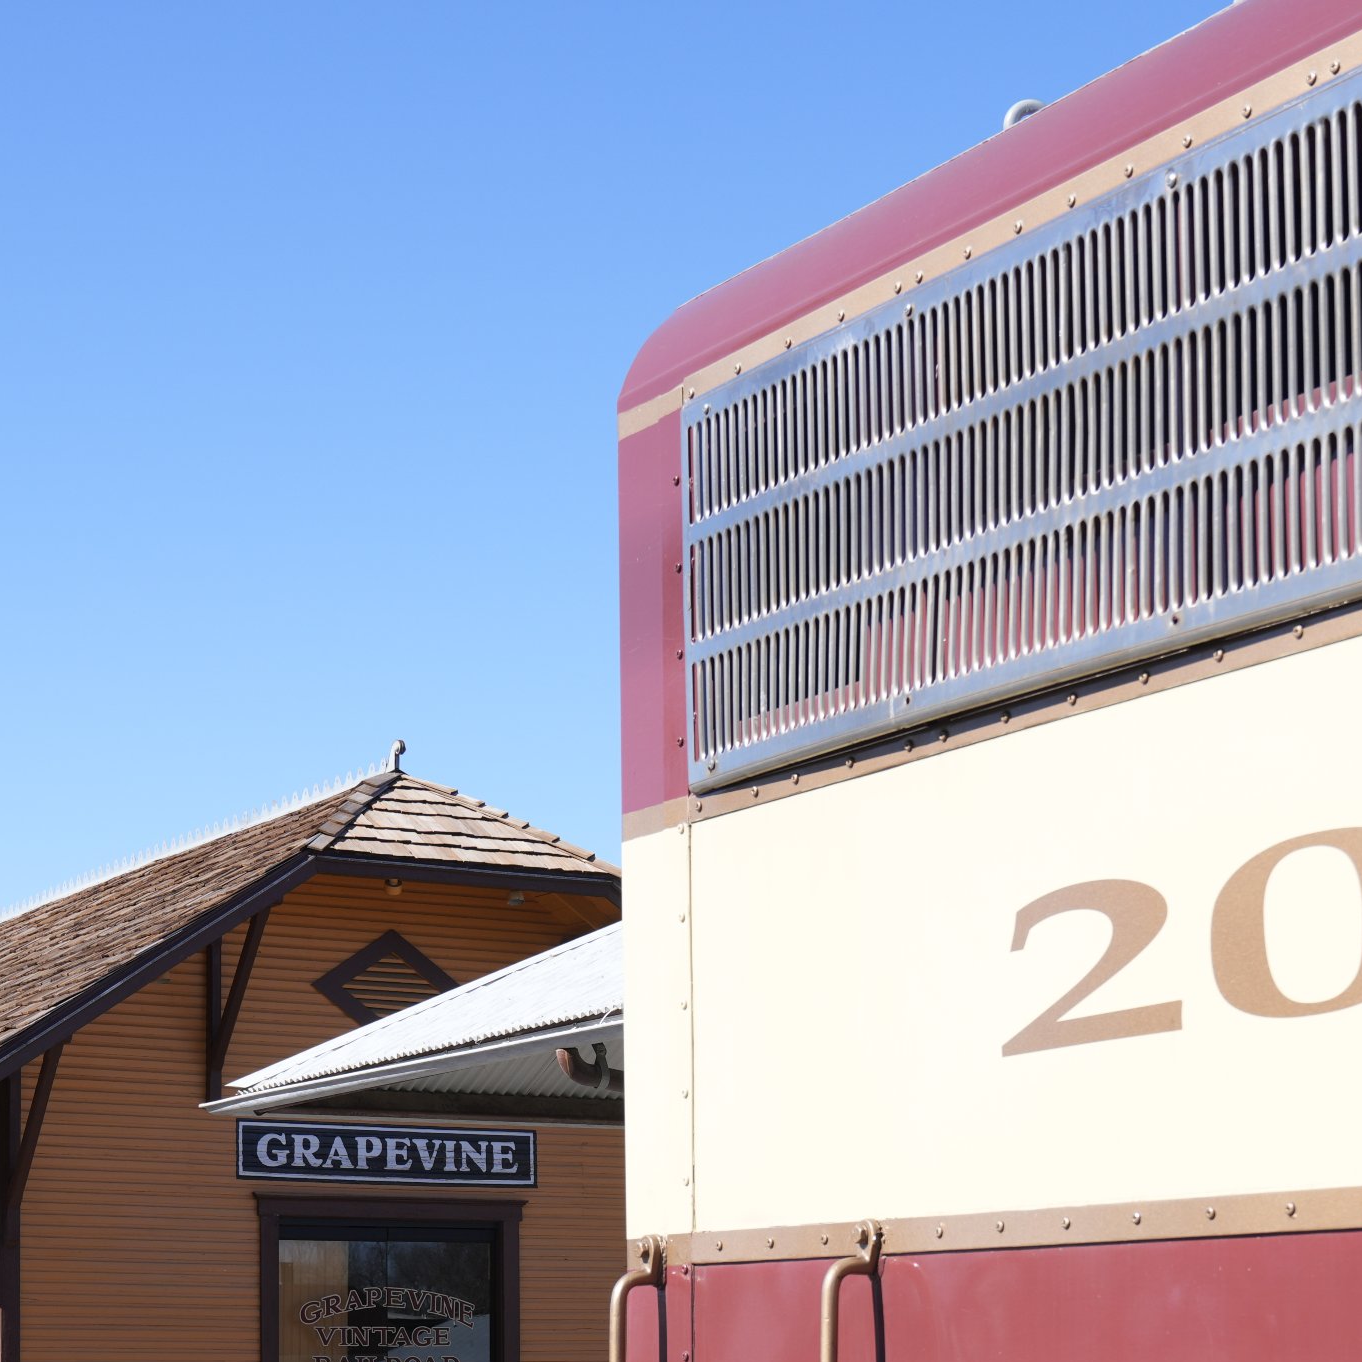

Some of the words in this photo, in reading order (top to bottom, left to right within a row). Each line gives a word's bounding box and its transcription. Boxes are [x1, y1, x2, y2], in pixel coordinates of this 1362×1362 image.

[255, 1132, 519, 1175] GRAPEVINE
[299, 1286, 476, 1329] GRAPEVINE
[315, 1326, 451, 1348] VINTAGE
